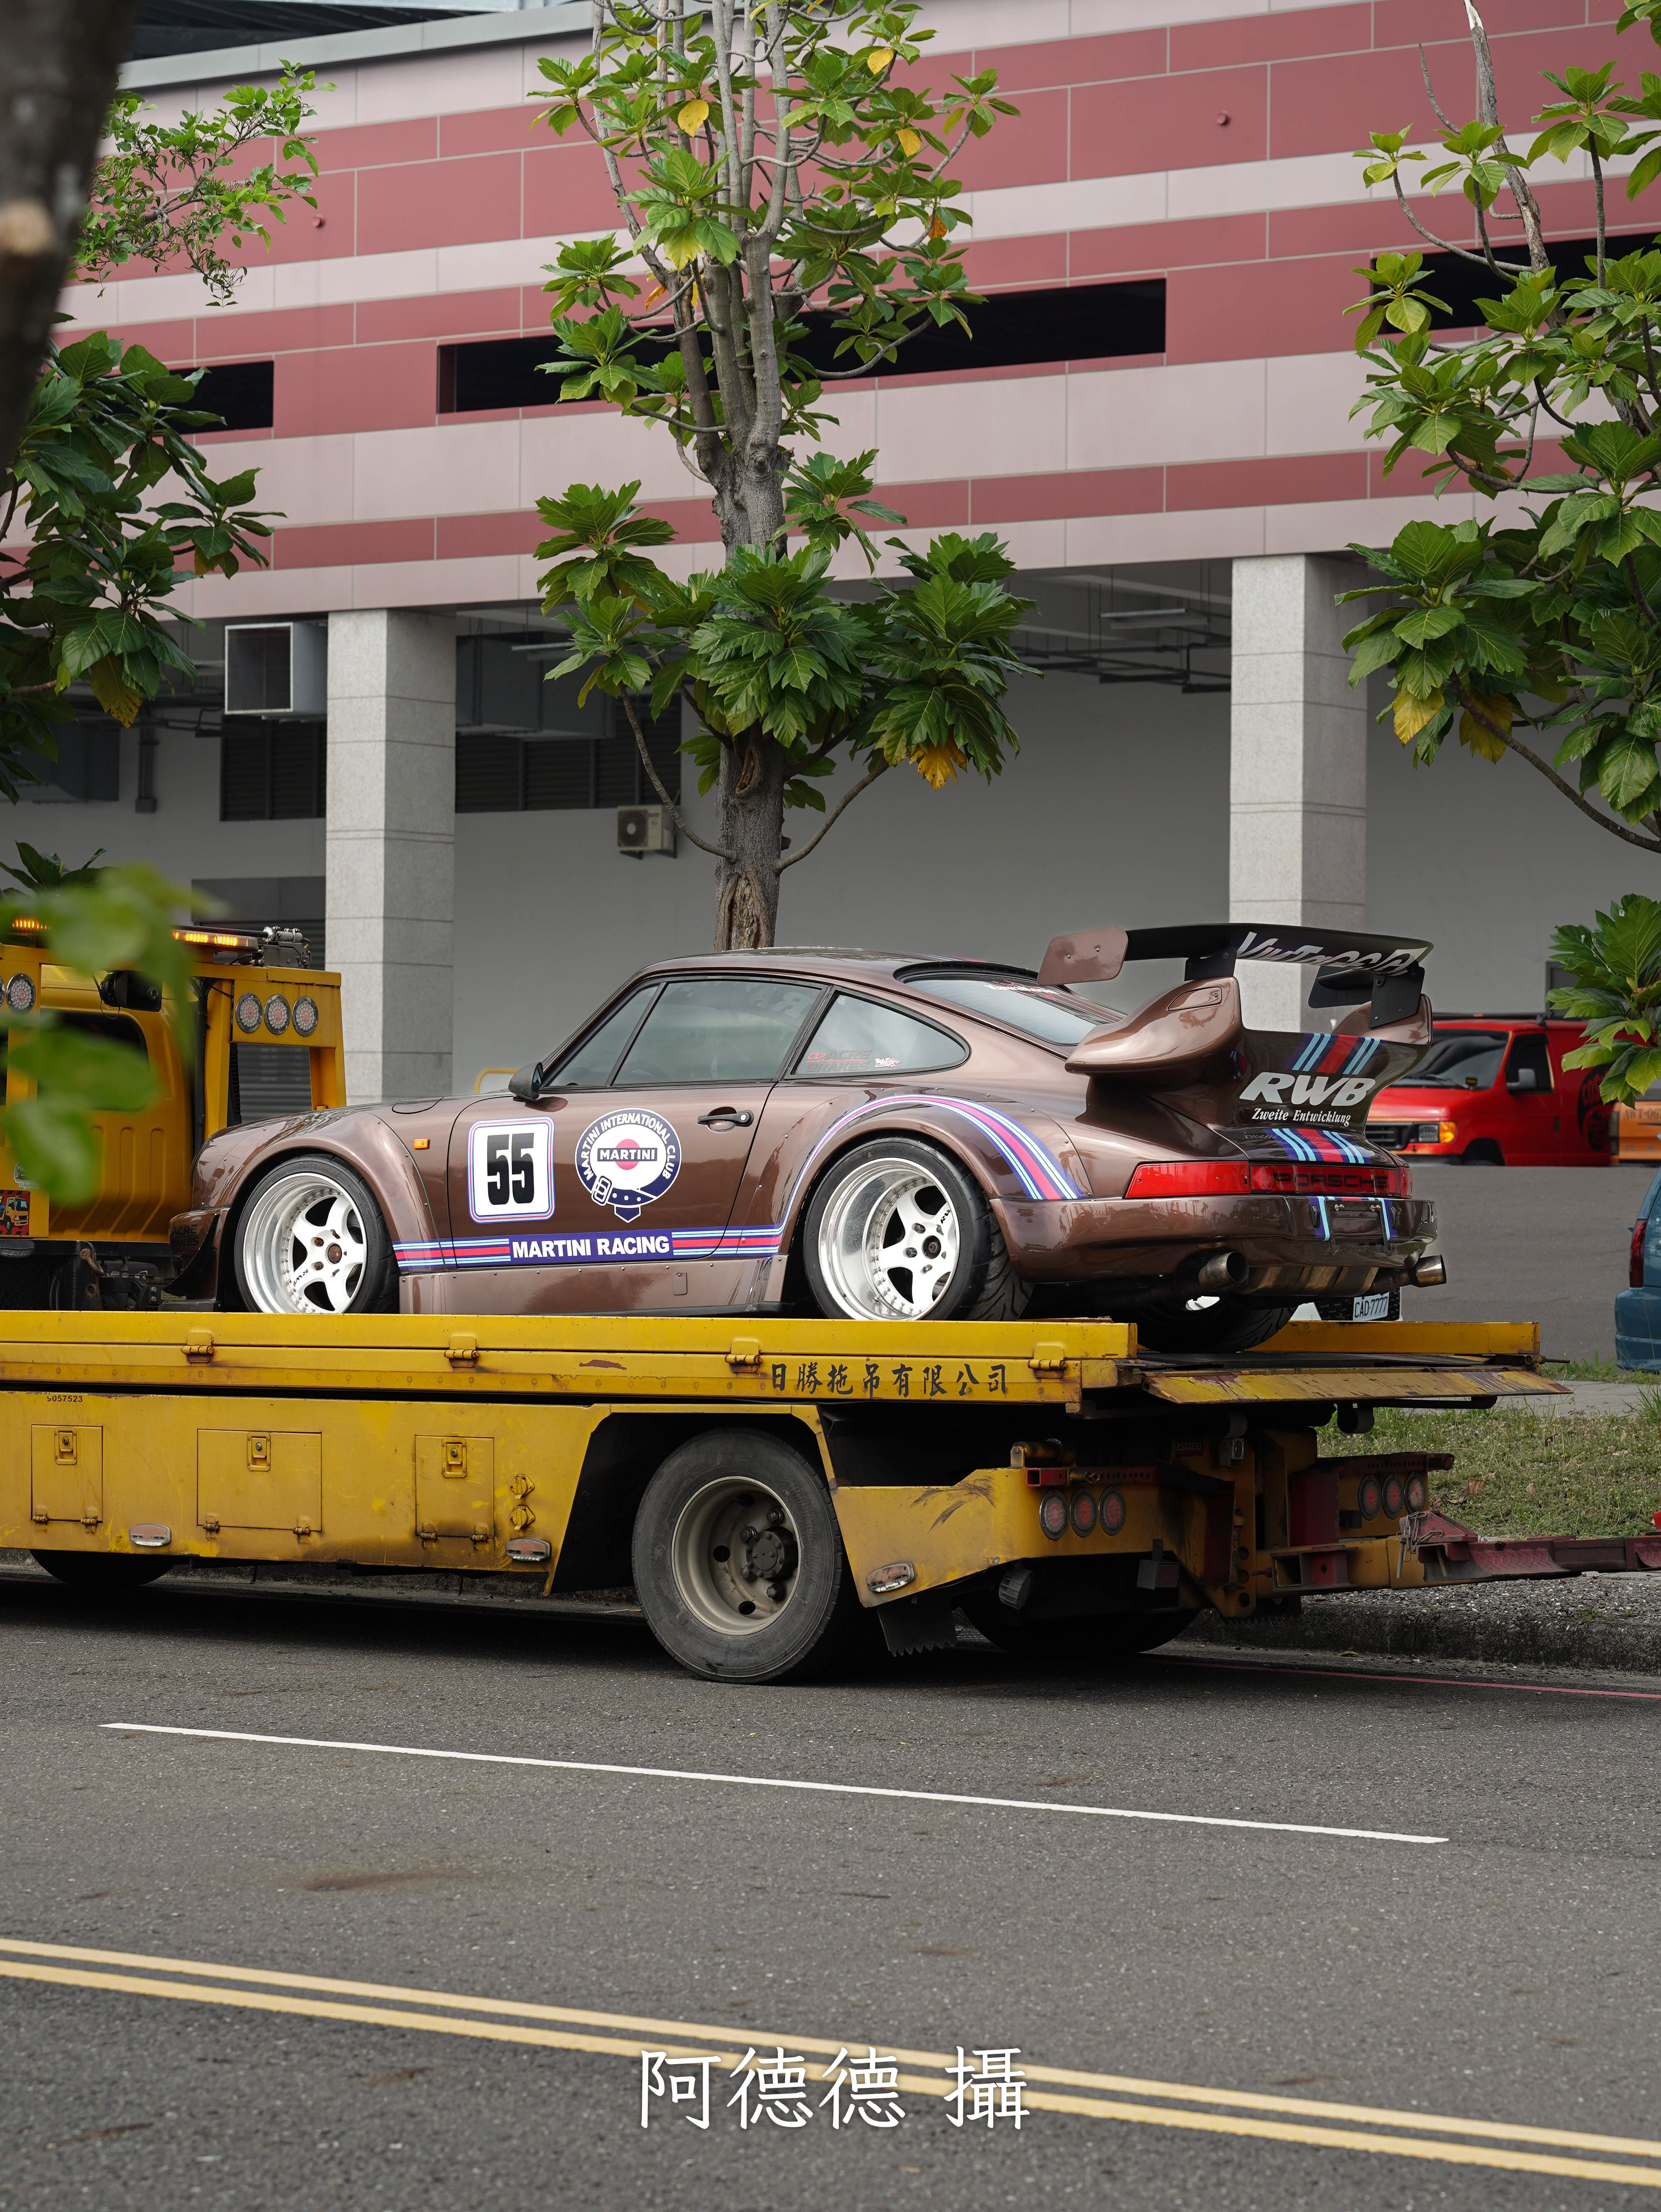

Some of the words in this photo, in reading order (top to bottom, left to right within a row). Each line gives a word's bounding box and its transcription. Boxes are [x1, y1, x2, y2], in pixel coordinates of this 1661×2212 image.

[806, 1062, 871, 1072] BRAKES
[1239, 1072, 1376, 1106] RWB
[1252, 1108, 1289, 1121] Zweite
[1292, 1109, 1351, 1127] Entwicklung
[581, 1126, 600, 1181] MARTINI
[600, 1113, 671, 1144] INTERNATIONAL
[662, 1145, 676, 1179] CLUB
[600, 1149, 655, 1160] MARTINI
[858, 1145, 904, 1160] TOYO
[299, 1162, 341, 1177] TOYO
[487, 1133, 534, 1205] 55
[1274, 1173, 1389, 1189] PORSCHE
[512, 1238, 592, 1258] MARTINI
[597, 1236, 670, 1255] RACING
[771, 1362, 1007, 1398] 日勝拖吊有限公司
[1177, 1442, 1202, 1451] ISUZU
